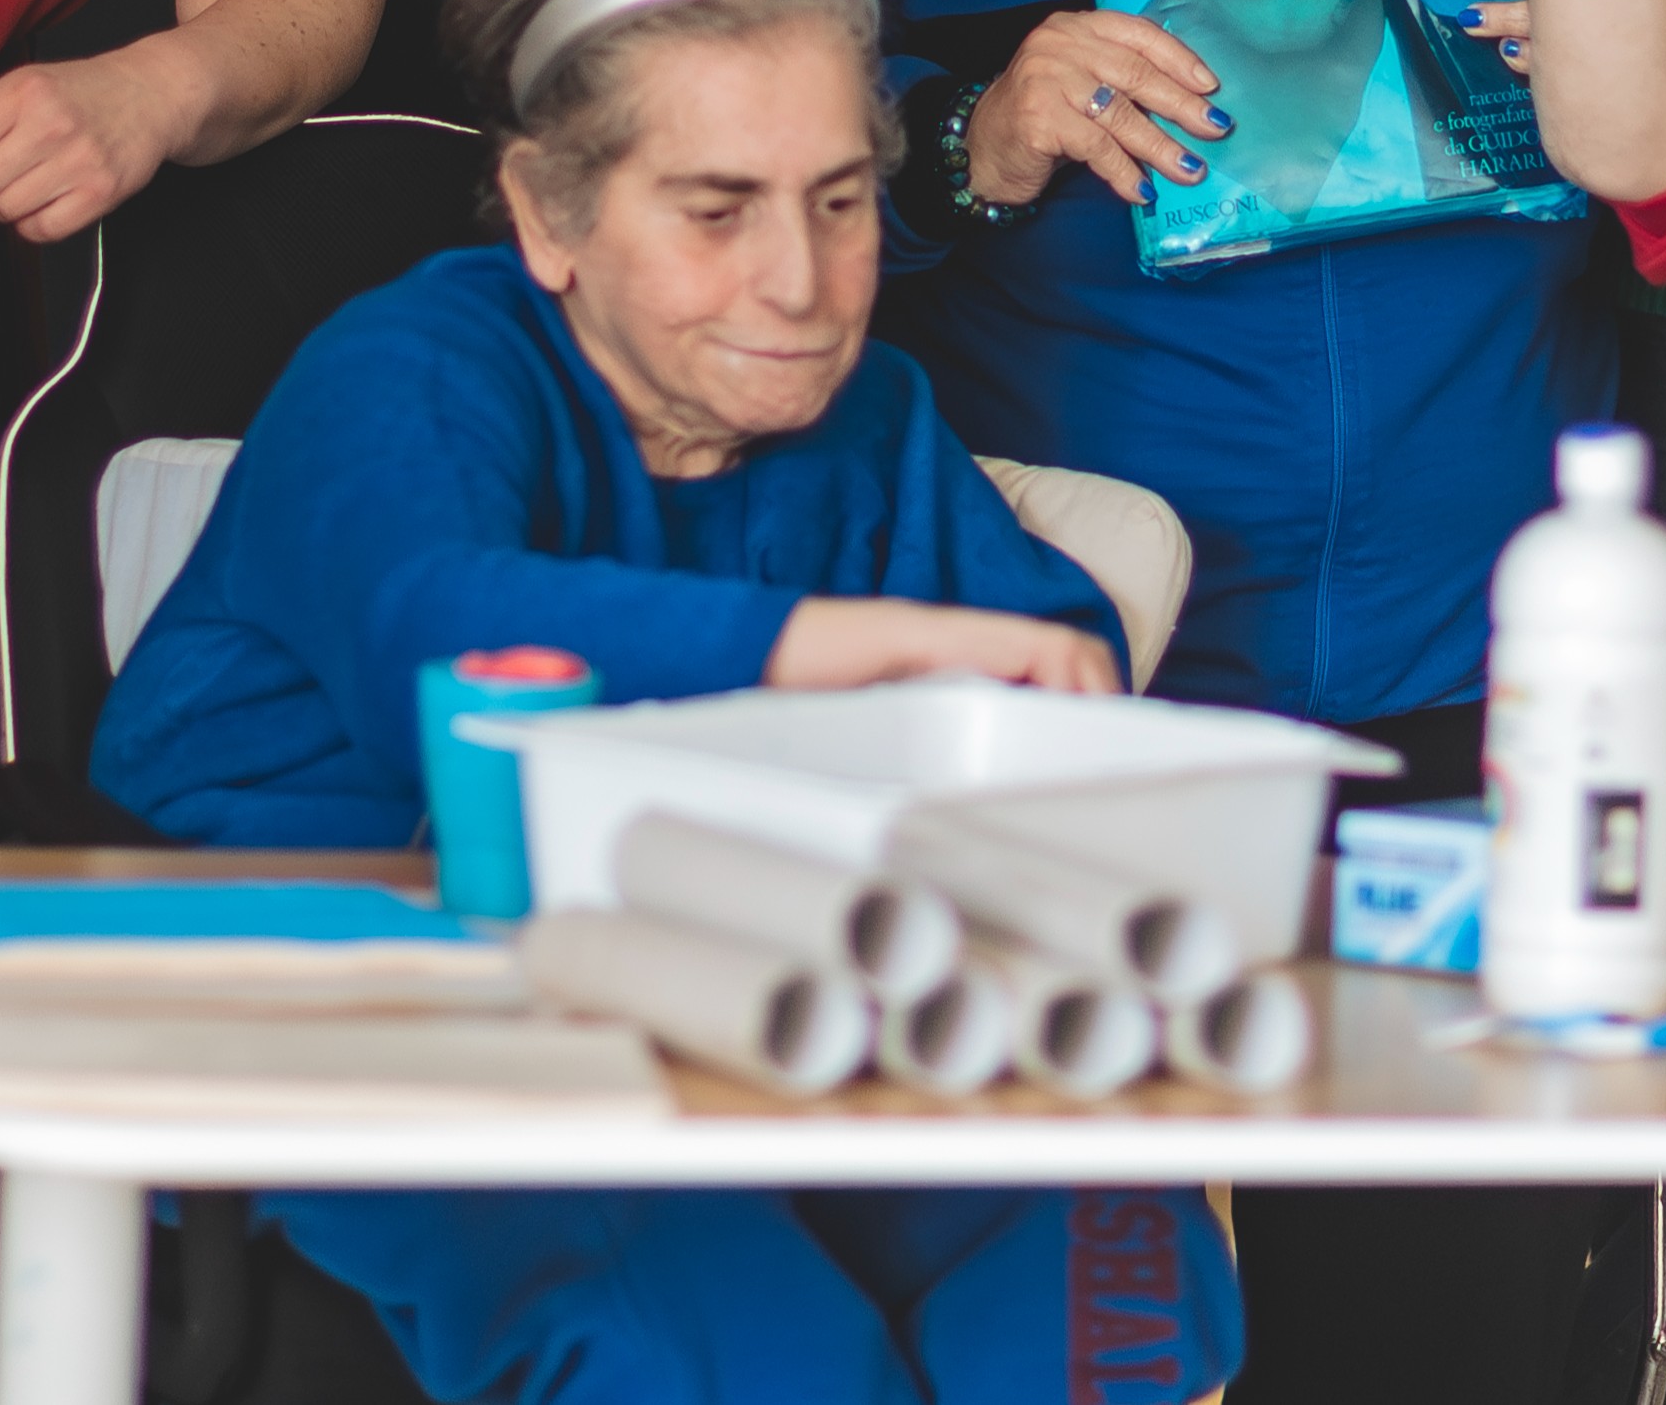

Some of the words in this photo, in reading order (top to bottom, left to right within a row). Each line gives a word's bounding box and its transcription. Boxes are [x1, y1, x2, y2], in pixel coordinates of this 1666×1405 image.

[1433, 120, 1444, 133] e
[1444, 136, 1466, 157] da
[1468, 128, 1540, 153] GUIDO
[1459, 151, 1546, 178] HARARI
[1164, 194, 1260, 228] RUSCONI
